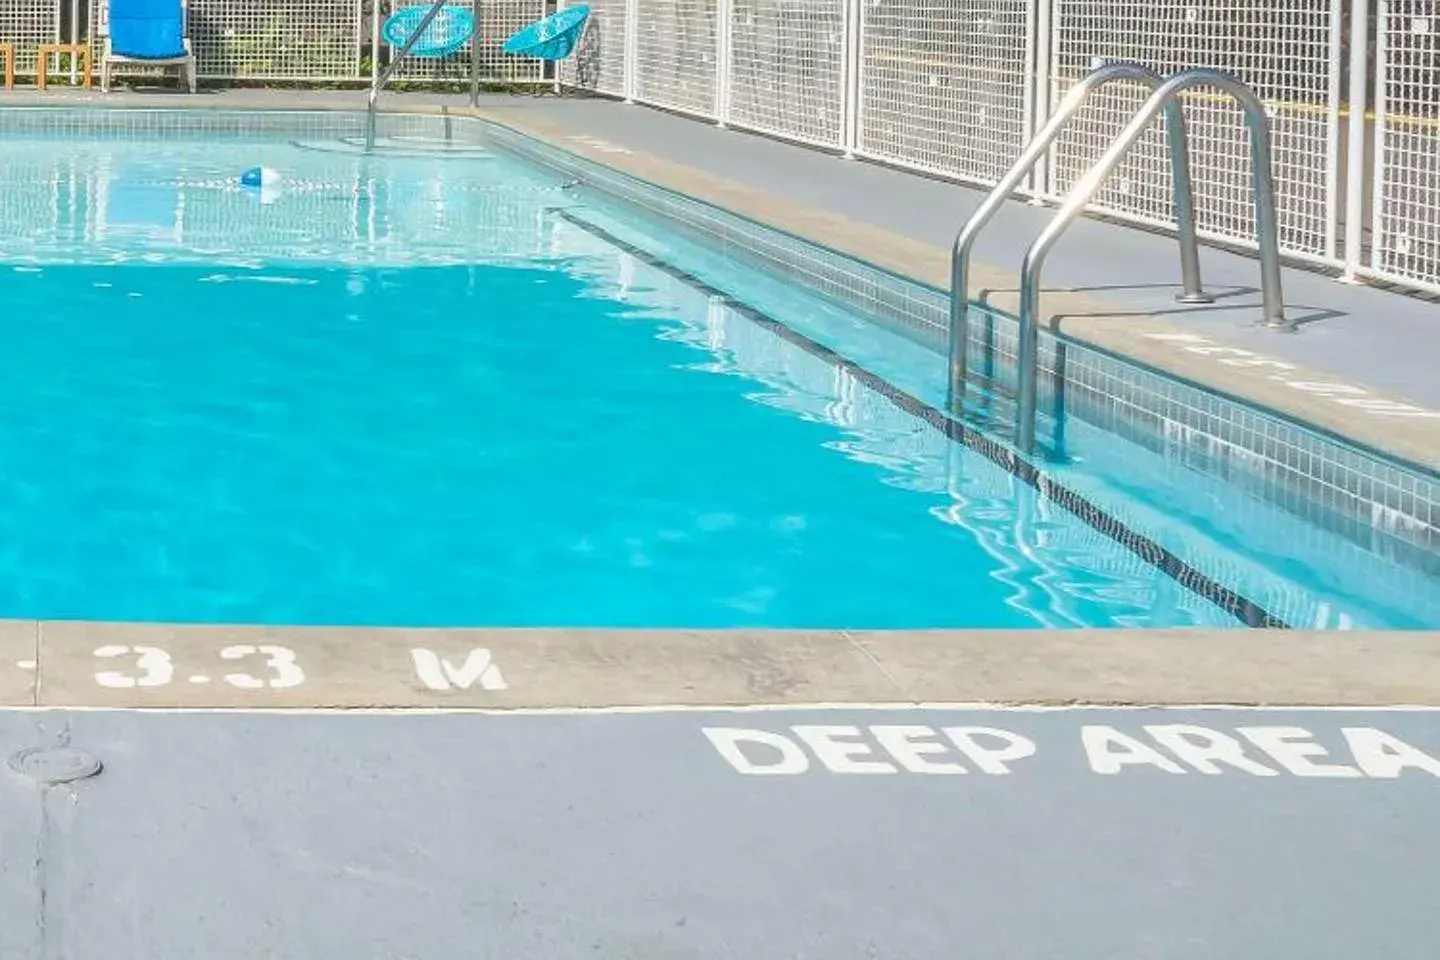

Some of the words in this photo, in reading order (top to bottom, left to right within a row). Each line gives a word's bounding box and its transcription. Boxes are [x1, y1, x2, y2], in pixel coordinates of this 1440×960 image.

[410, 648, 508, 690] M
[701, 725, 1037, 776] DEEP
[1080, 724, 1440, 779] AREA
